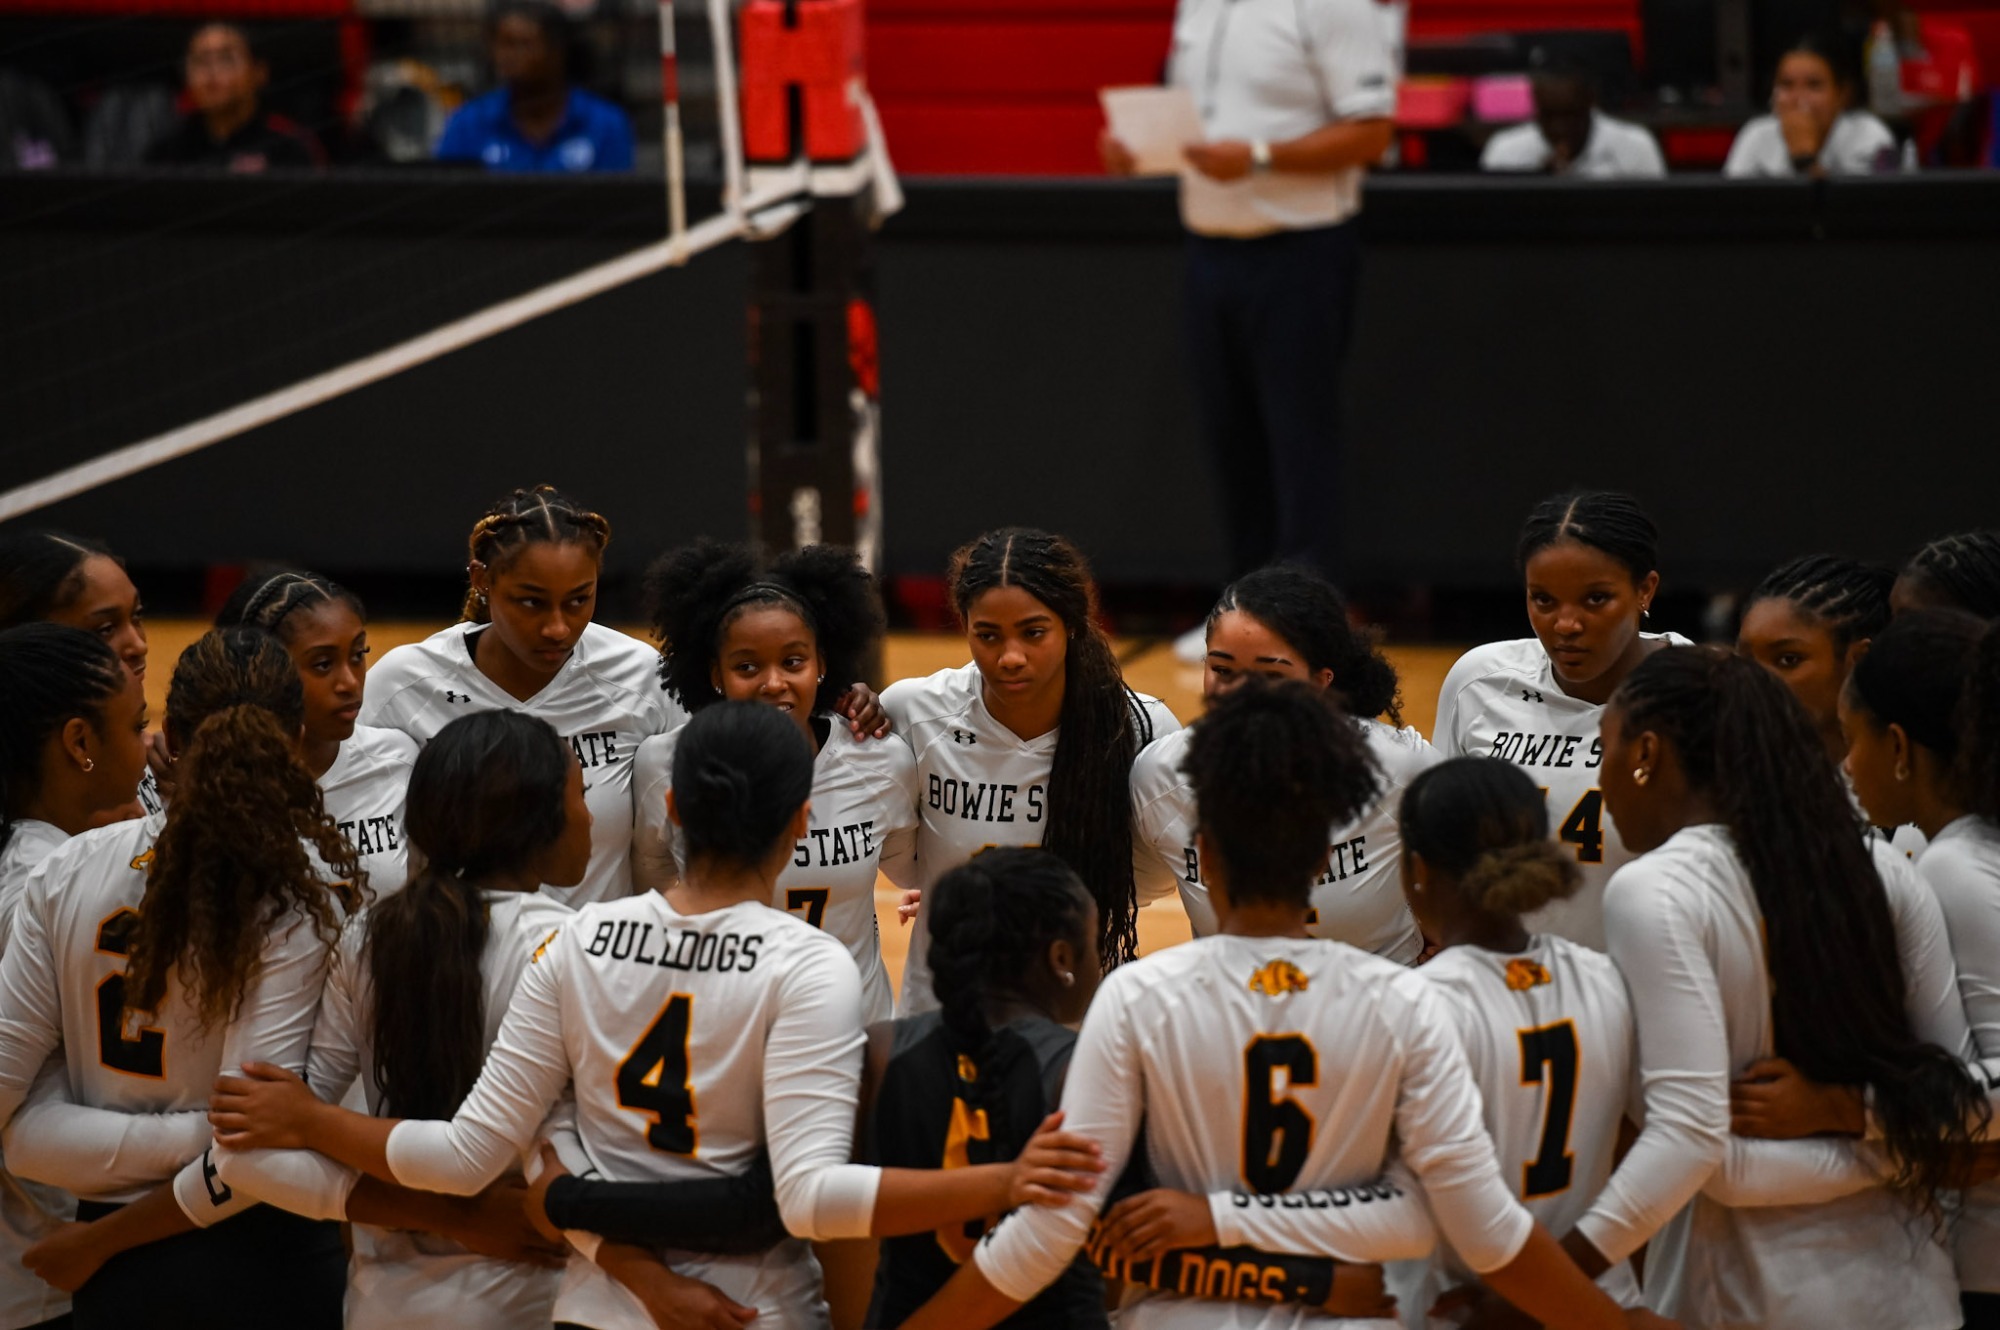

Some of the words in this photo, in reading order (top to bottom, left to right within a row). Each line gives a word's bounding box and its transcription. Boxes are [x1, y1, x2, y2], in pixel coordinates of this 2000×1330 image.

[560, 731, 619, 768] ATE
[1488, 732, 1583, 768] BOWIE
[928, 773, 1018, 822] BOWIE
[336, 814, 398, 856] TATE
[1537, 785, 1604, 864] 4
[584, 920, 763, 973] BULLDOGS
[612, 991, 698, 1159] 4
[1239, 1031, 1320, 1196] 6
[1516, 1016, 1582, 1202] 7
